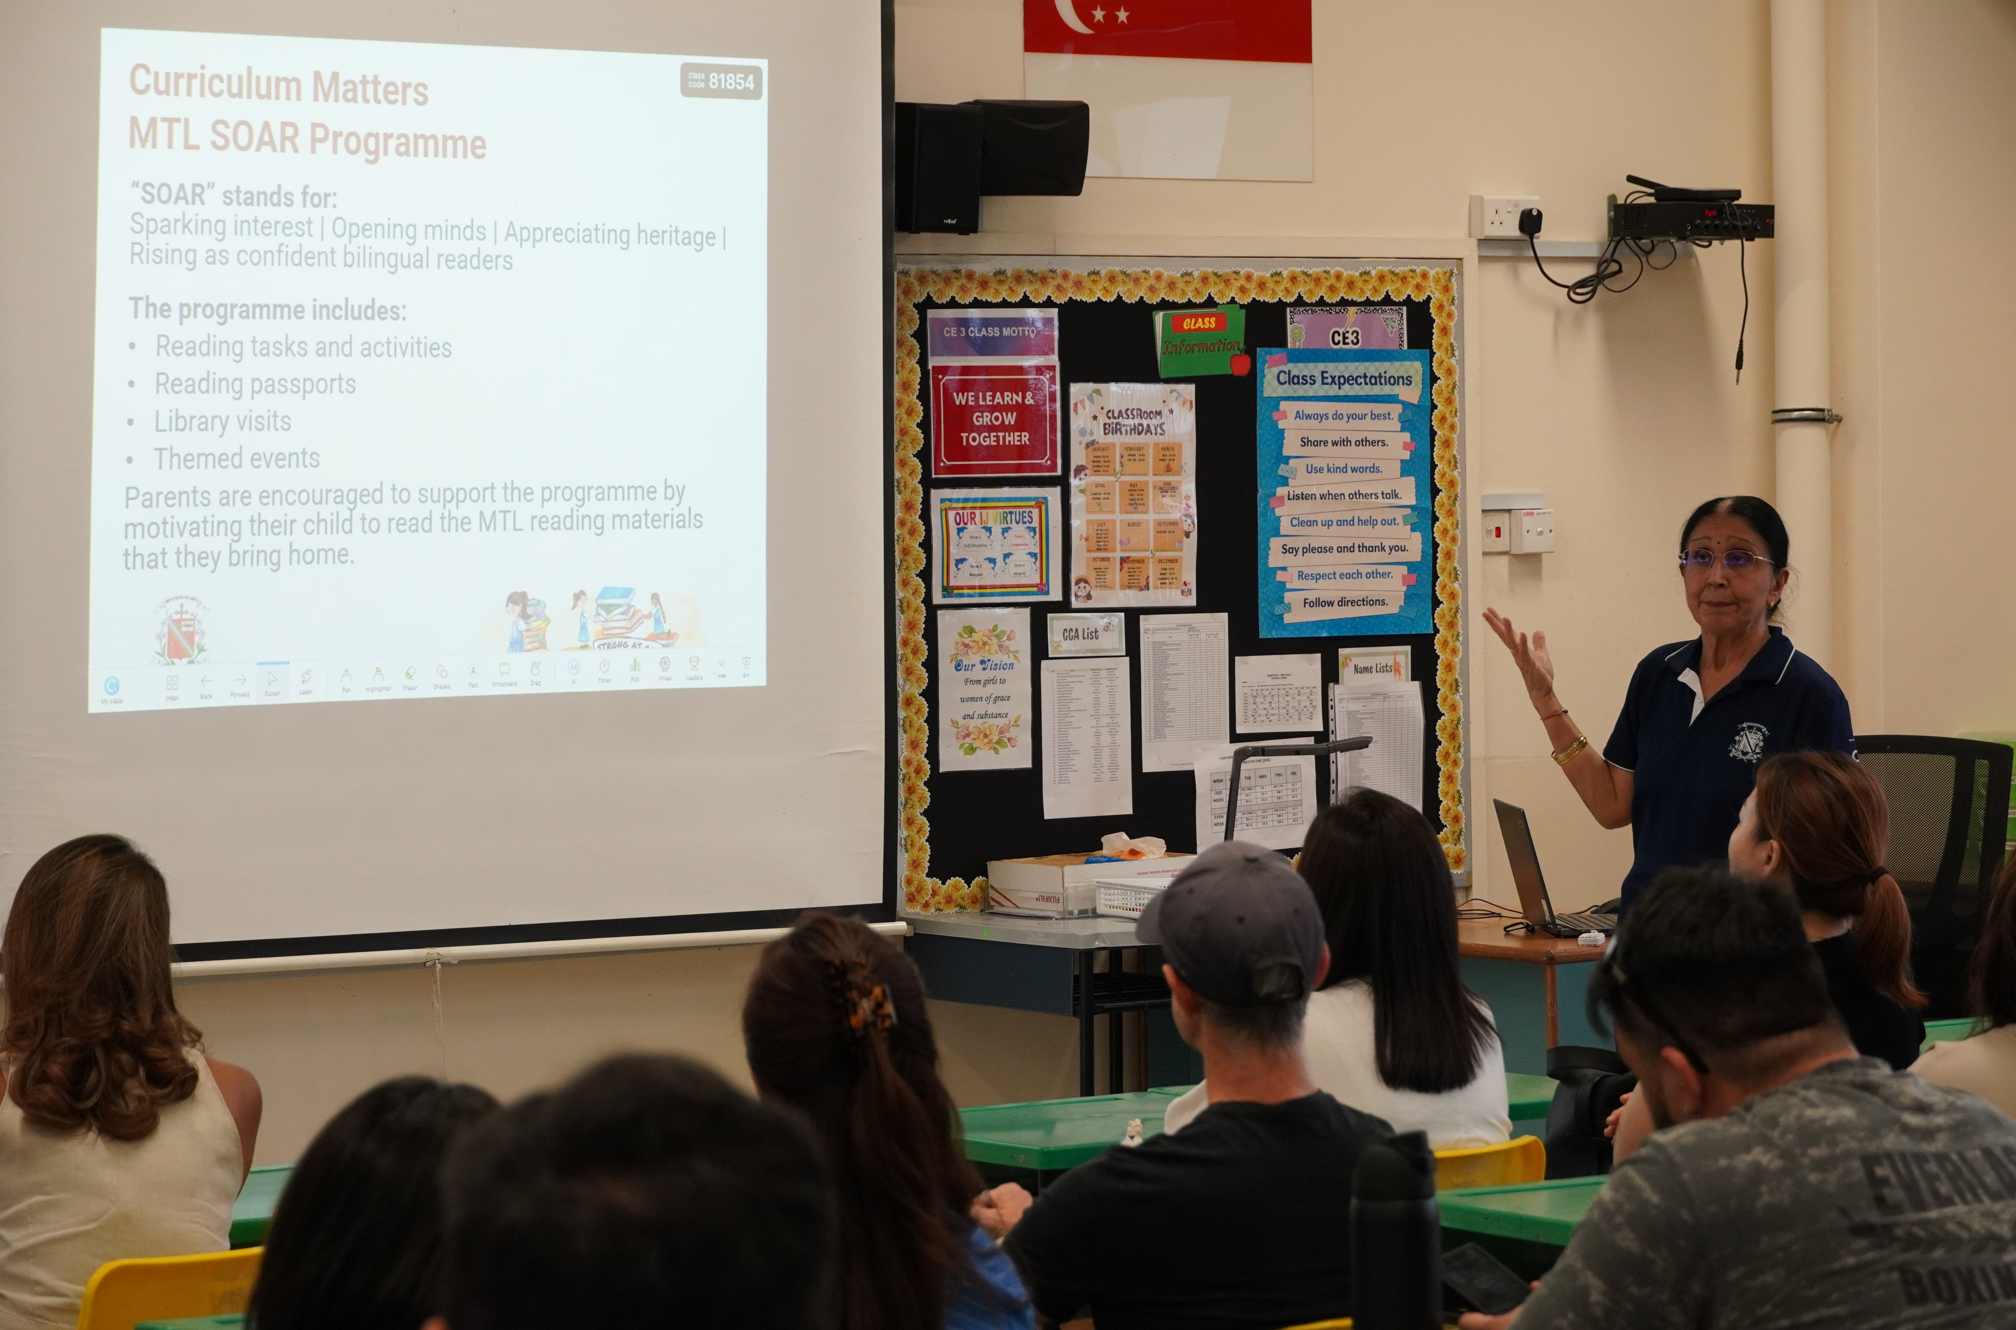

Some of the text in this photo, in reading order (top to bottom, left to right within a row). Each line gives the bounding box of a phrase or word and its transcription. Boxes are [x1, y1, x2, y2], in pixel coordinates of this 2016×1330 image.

[688, 71, 705, 80] class
[709, 72, 755, 91] 81854
[129, 62, 430, 107] Curriculum Matters
[688, 80, 705, 88] code
[128, 115, 487, 165] MTL SOAR Programme
[222, 183, 294, 208] stands
[300, 184, 338, 209] for:
[129, 212, 717, 253] Sparking interest Opening minds Appreciating heritage
[129, 241, 513, 275] Rising as confident bilingual readers
[129, 295, 407, 326] The programme includes:
[1183, 317, 1216, 329] CLASS
[944, 327, 1037, 338] CE 3 CLASS MOTTO
[1331, 330, 1360, 346] CE3
[156, 333, 453, 363] Reading tasks and activities
[1163, 338, 1240, 355] Information
[155, 370, 357, 400] Reading passports
[1276, 369, 1413, 390] Class Expectations
[953, 391, 1035, 406] WE LEARN &
[973, 412, 1017, 426] GROW
[1105, 408, 1163, 420] CLASSROOM
[1294, 410, 1394, 424] Always do your best.
[154, 409, 292, 439] Library visits
[961, 432, 1030, 446] TOGETHER
[1300, 436, 1389, 447] Share with others.
[154, 446, 321, 471] Themed events
[1306, 463, 1383, 474] Use kind words.
[125, 478, 686, 512] Parents are encouraged to support the programme by
[1287, 489, 1402, 501] Listen when others talk.
[124, 506, 703, 544] motivating their child to read the MTL reading materials
[954, 510, 1034, 526] OUR IJ VIRTUES
[1290, 516, 1400, 529] Clean up and help out.
[1281, 542, 1409, 557] Say please and thank you.
[122, 542, 355, 574] that they bring home.
[1297, 569, 1393, 583] Respect each other.
[1303, 597, 1389, 608] Follow directions.
[1063, 626, 1100, 642] CCA List
[954, 658, 1015, 672] Our Vision
[1354, 662, 1393, 675] Name Lists
[964, 676, 1007, 688] From girls to
[100, 698, 109, 706] My
[960, 693, 1011, 705] women of grace
[962, 711, 1009, 720] and substance
